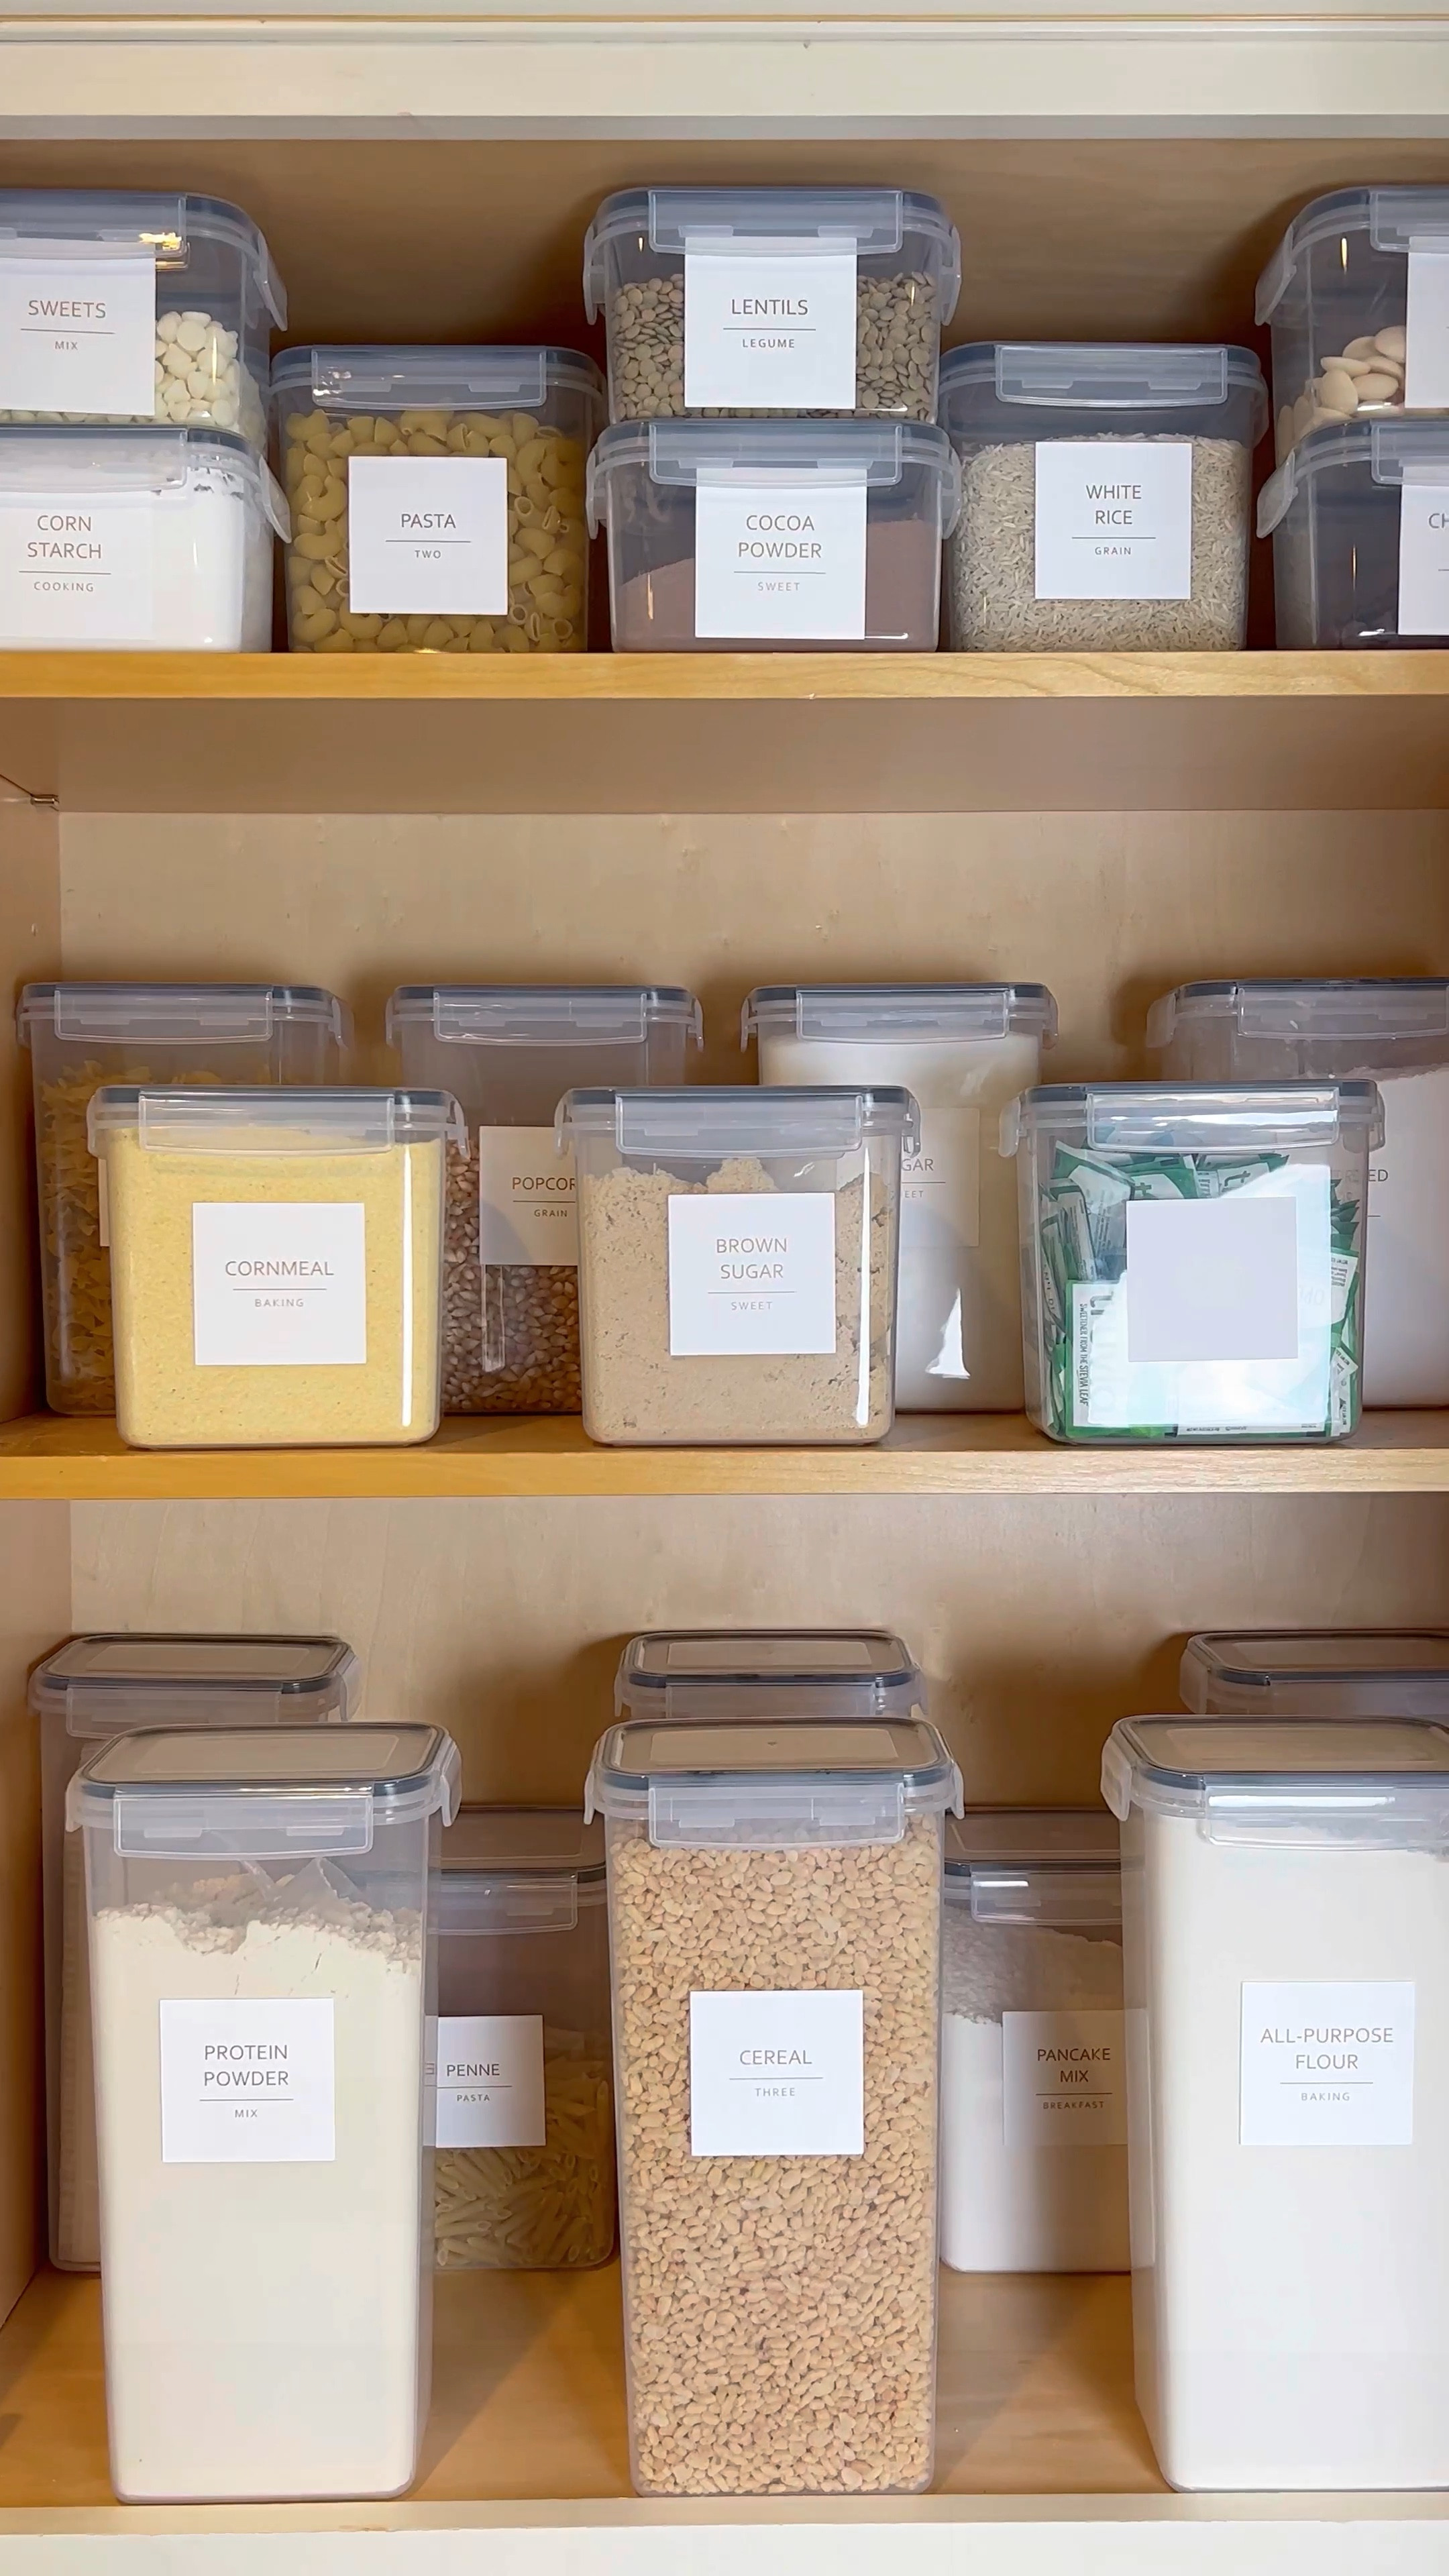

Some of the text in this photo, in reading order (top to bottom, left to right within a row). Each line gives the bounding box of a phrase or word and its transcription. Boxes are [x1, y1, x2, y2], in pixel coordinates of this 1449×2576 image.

[28, 300, 106, 319] SWEETS
[731, 299, 808, 315] LENTILS
[54, 340, 78, 351] MIX
[742, 338, 795, 348] LEGUME
[1085, 484, 1142, 500] WHITE
[37, 515, 91, 532] CORN
[401, 513, 456, 529] PASTA
[746, 515, 815, 531] COCOA
[1095, 510, 1133, 525] RICE
[27, 541, 101, 559] STARCH
[414, 549, 441, 559] TWO
[739, 541, 822, 559] POWDER
[1094, 546, 1131, 555] GRAIN
[34, 581, 94, 592] COOKING
[757, 581, 800, 592] SWEET
[533, 1209, 568, 1218] GRAIN
[716, 1237, 787, 1254] BROWN
[225, 1260, 335, 1277] CORNMEAL
[720, 1263, 784, 1279] SUGAR
[254, 1298, 304, 1307] BAKING
[730, 1301, 773, 1311] SWEET
[1079, 1365, 1089, 1387] STEVIA
[1079, 1388, 1089, 1407] LEAF
[1260, 2027, 1393, 2043] ALL-PURPOSE
[205, 2044, 287, 2061] PROTEIN
[739, 2049, 813, 2065] CEREAL
[1037, 2047, 1111, 2061] PANCAKE
[1296, 2053, 1358, 2070] FLOUR
[446, 2063, 500, 2077] PENNE
[1060, 2070, 1089, 2083] MIX
[204, 2070, 288, 2086] POWDER
[456, 2094, 490, 2102] PASTA
[754, 2087, 796, 2097] THREE
[1301, 2092, 1350, 2102] BAKING
[1042, 2100, 1105, 2110] BREAKFAST
[235, 2108, 258, 2118] MIX
